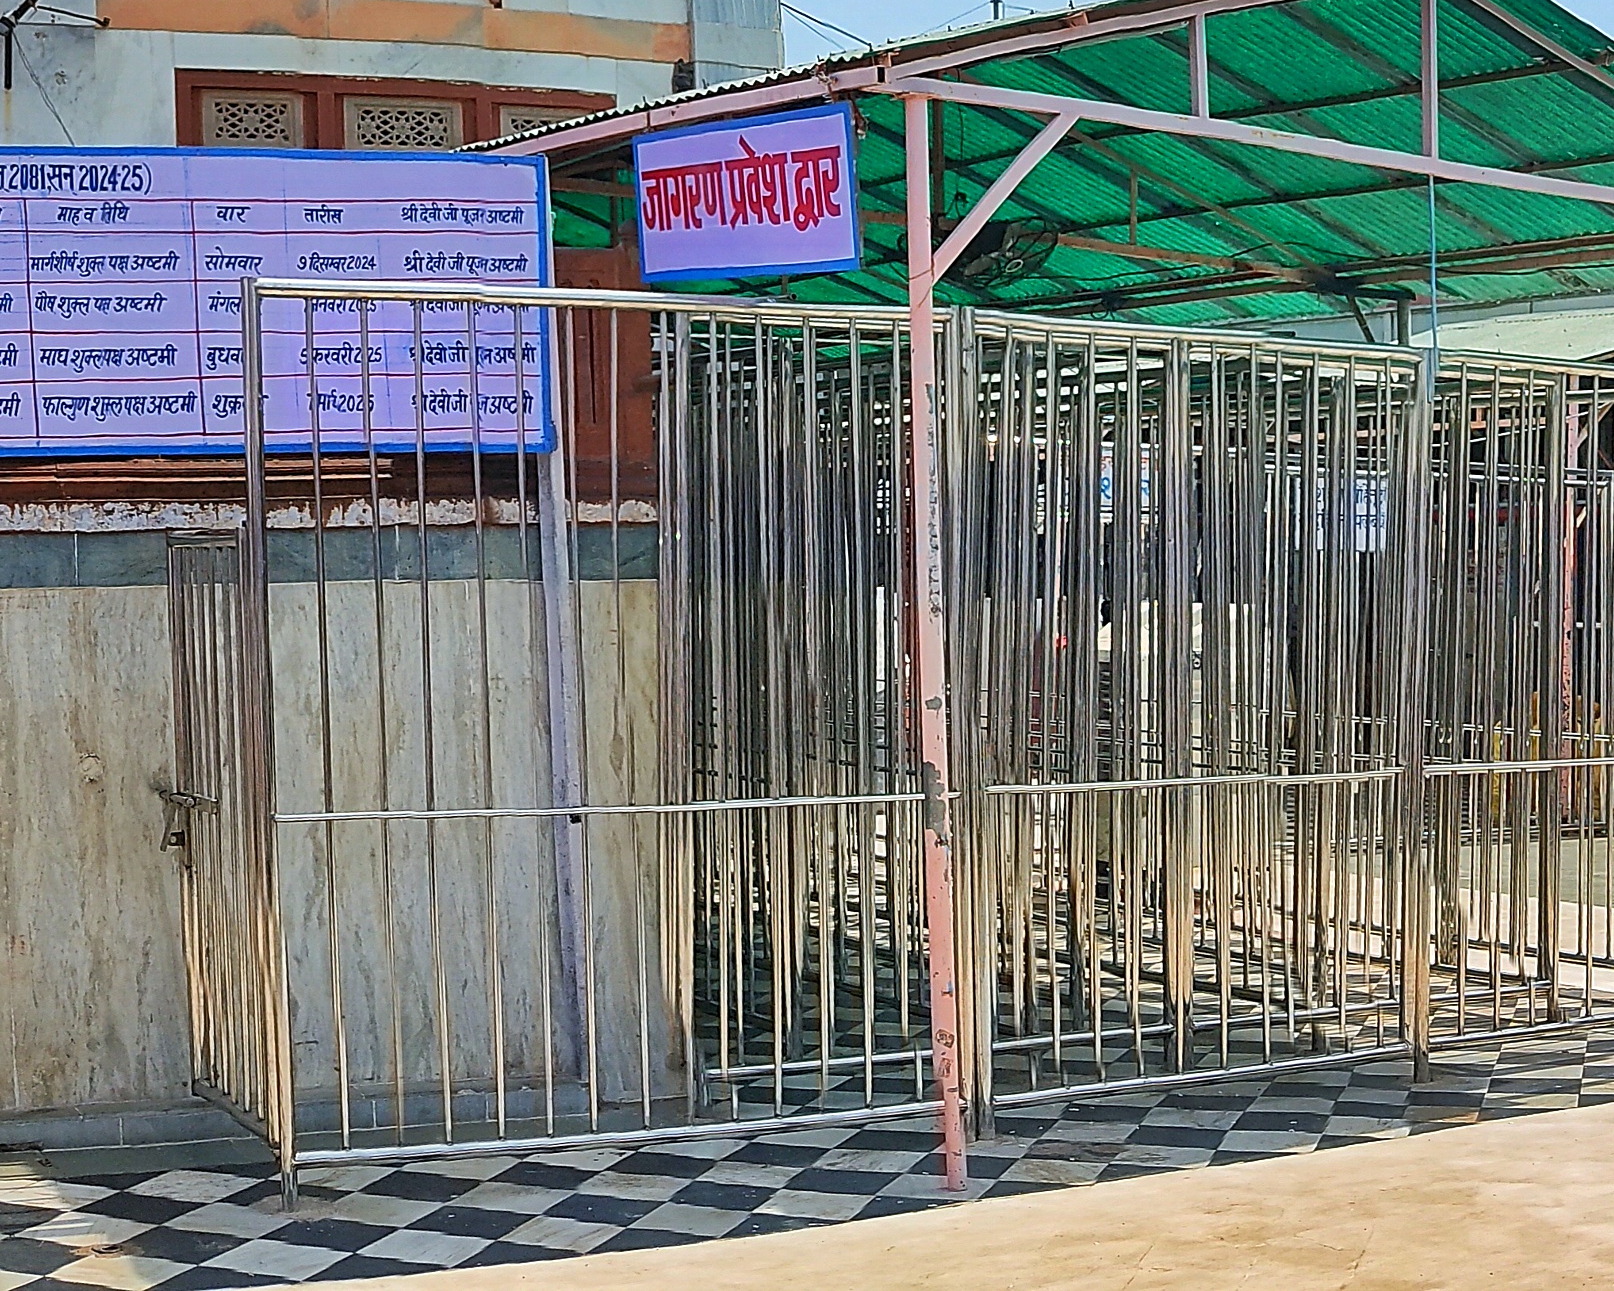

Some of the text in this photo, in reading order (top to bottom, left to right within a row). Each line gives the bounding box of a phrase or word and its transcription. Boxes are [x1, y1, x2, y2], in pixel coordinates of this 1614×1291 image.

[641, 135, 842, 233] जागरण प्रवेश द्वार
[216, 206, 251, 223] वार
[204, 246, 263, 275] सोमवार
[126, 343, 178, 369] अष्टमी
[147, 390, 198, 415] अष्टमी
